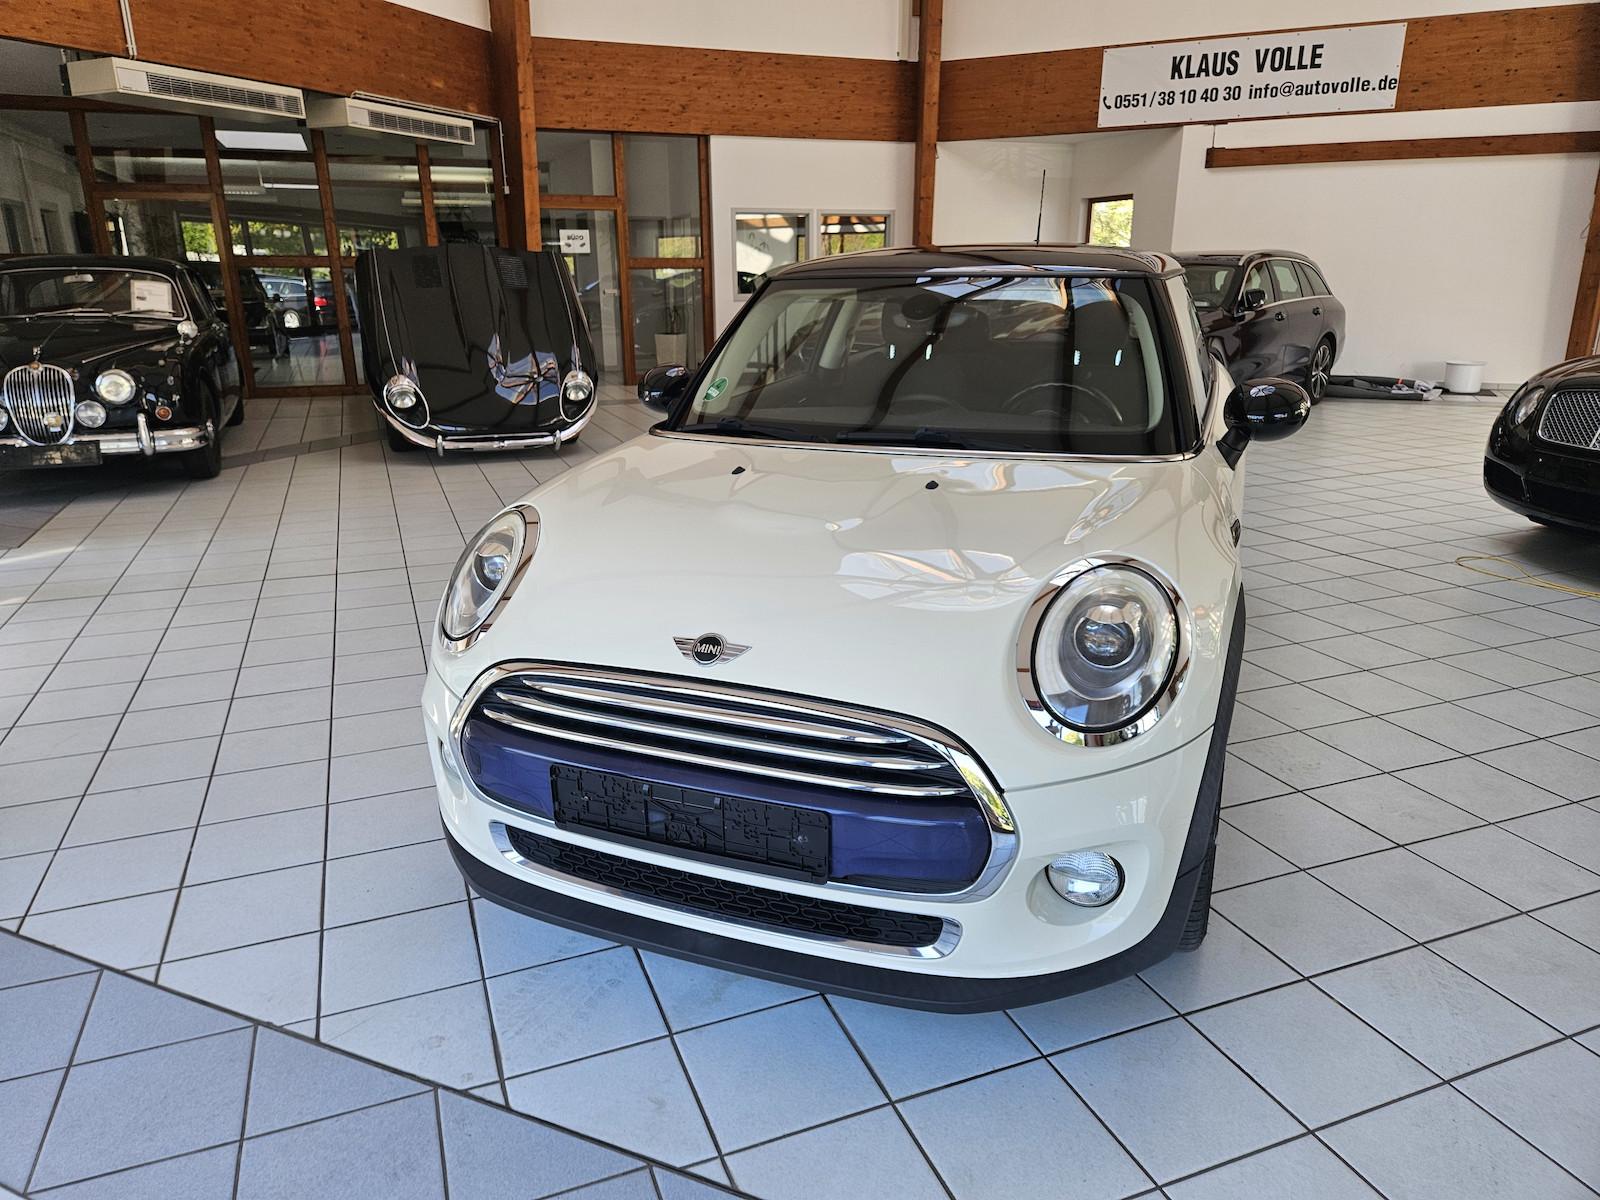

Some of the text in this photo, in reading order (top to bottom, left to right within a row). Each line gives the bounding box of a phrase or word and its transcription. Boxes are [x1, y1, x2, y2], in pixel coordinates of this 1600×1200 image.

[1170, 44, 1324, 80] KLAUS VOLLE
[1179, 89, 1197, 104] 10
[1201, 87, 1219, 103] 40
[1223, 85, 1242, 101] 30
[1248, 74, 1398, 100] info@autovolle.de
[695, 642, 721, 655] MINI
